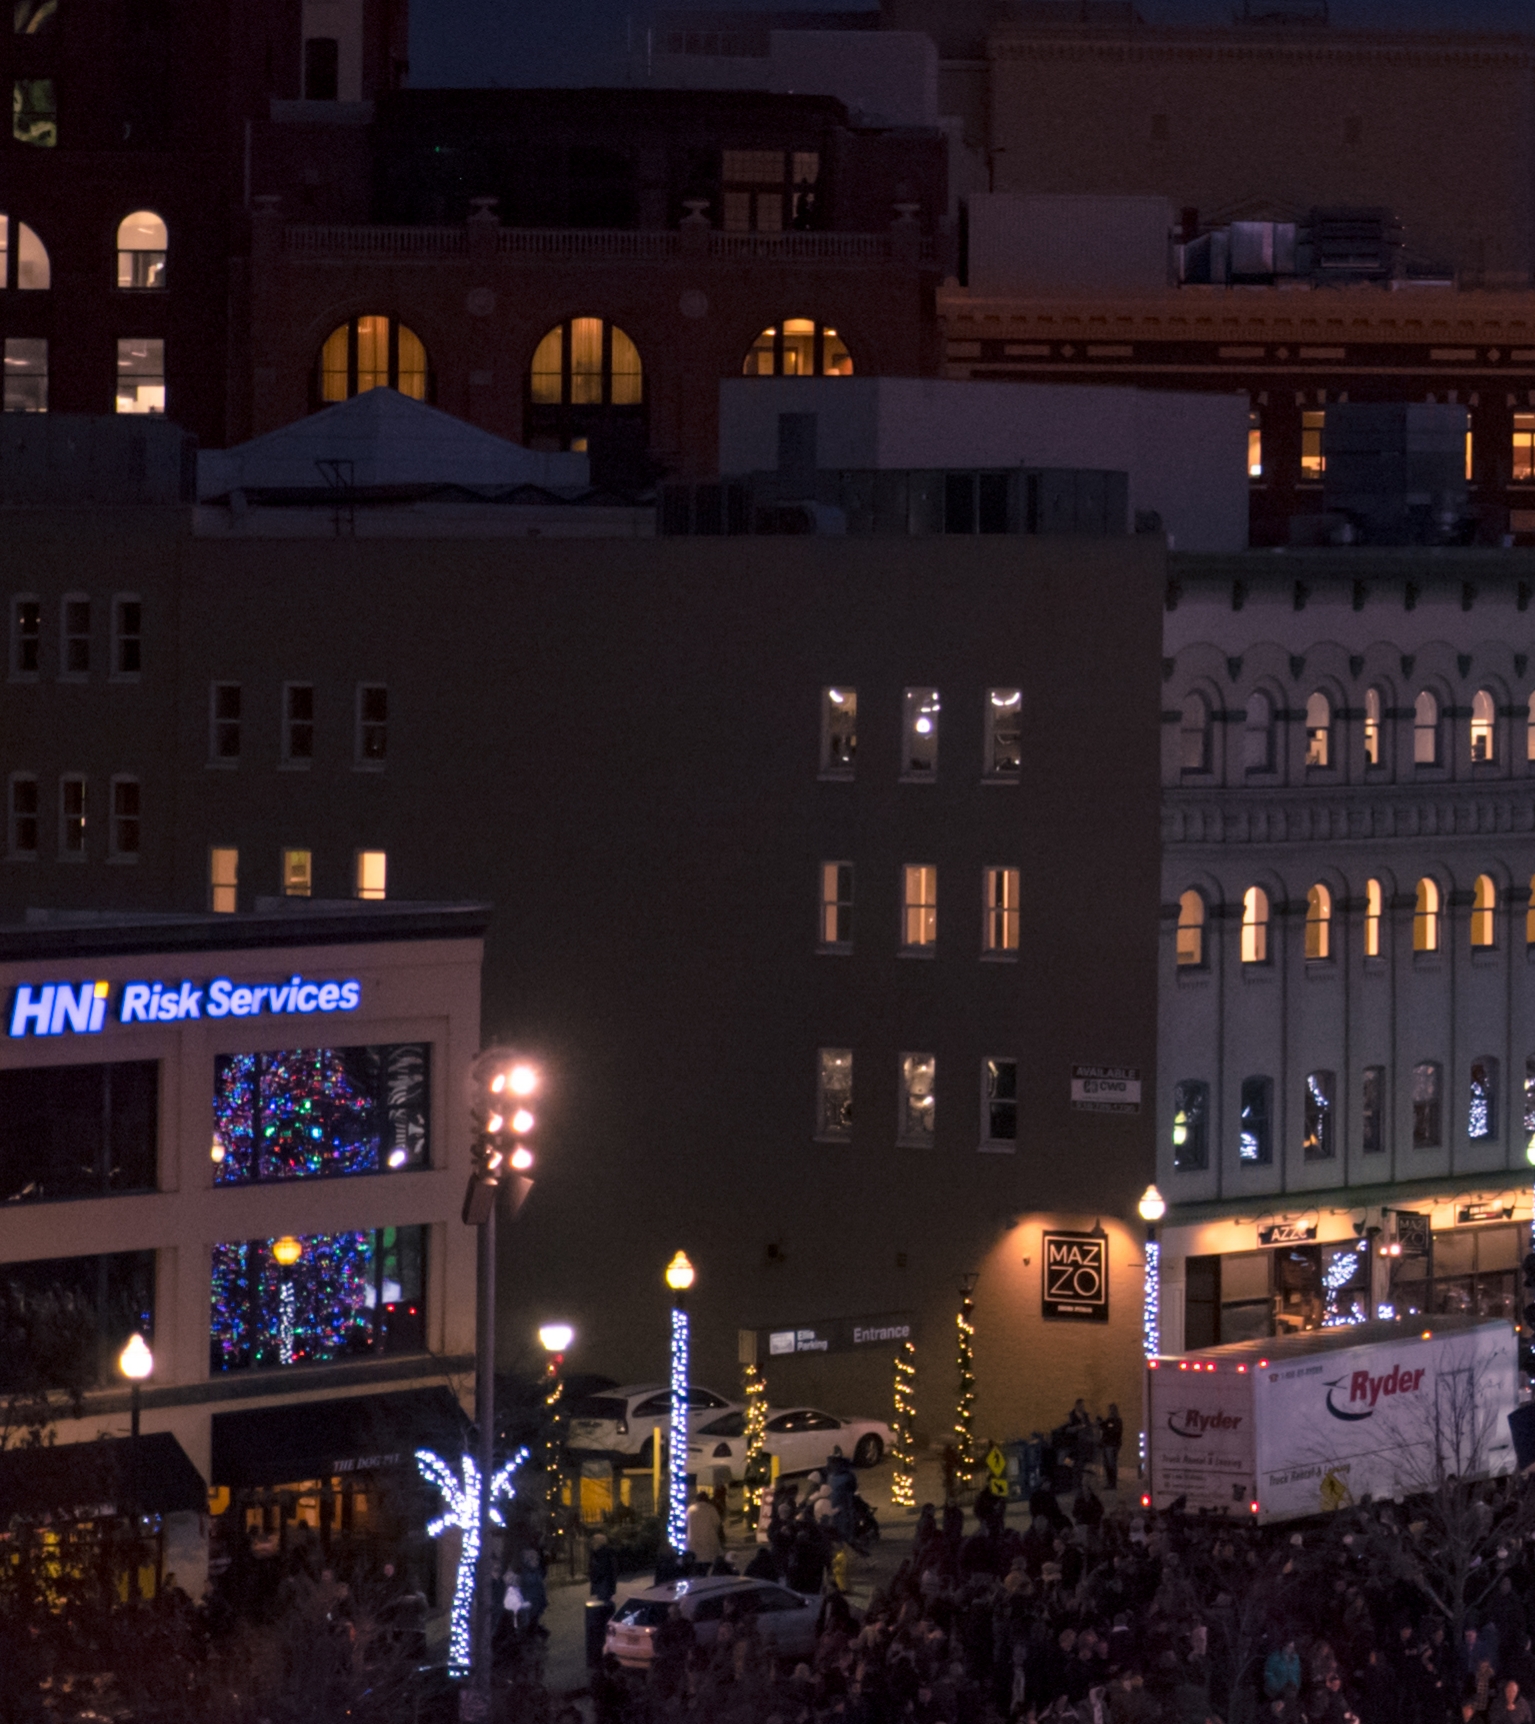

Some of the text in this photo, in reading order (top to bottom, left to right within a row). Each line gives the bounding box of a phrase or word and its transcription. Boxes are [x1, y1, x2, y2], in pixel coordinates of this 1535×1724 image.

[121, 979, 203, 1023] Risk
[206, 974, 361, 1018] Services
[1076, 1066, 1136, 1079] AVAILABLE
[1049, 1243, 1099, 1266] MAZ
[1050, 1266, 1100, 1297] ZO
[853, 1325, 910, 1343] Entrance
[797, 1340, 828, 1351] Parking
[1350, 1364, 1425, 1406] Ryder
[1185, 1409, 1243, 1431] Ryder
[1183, 1455, 1206, 1465] Rental
[1269, 1475, 1288, 1486] Truck
[1291, 1467, 1315, 1481] Rental
